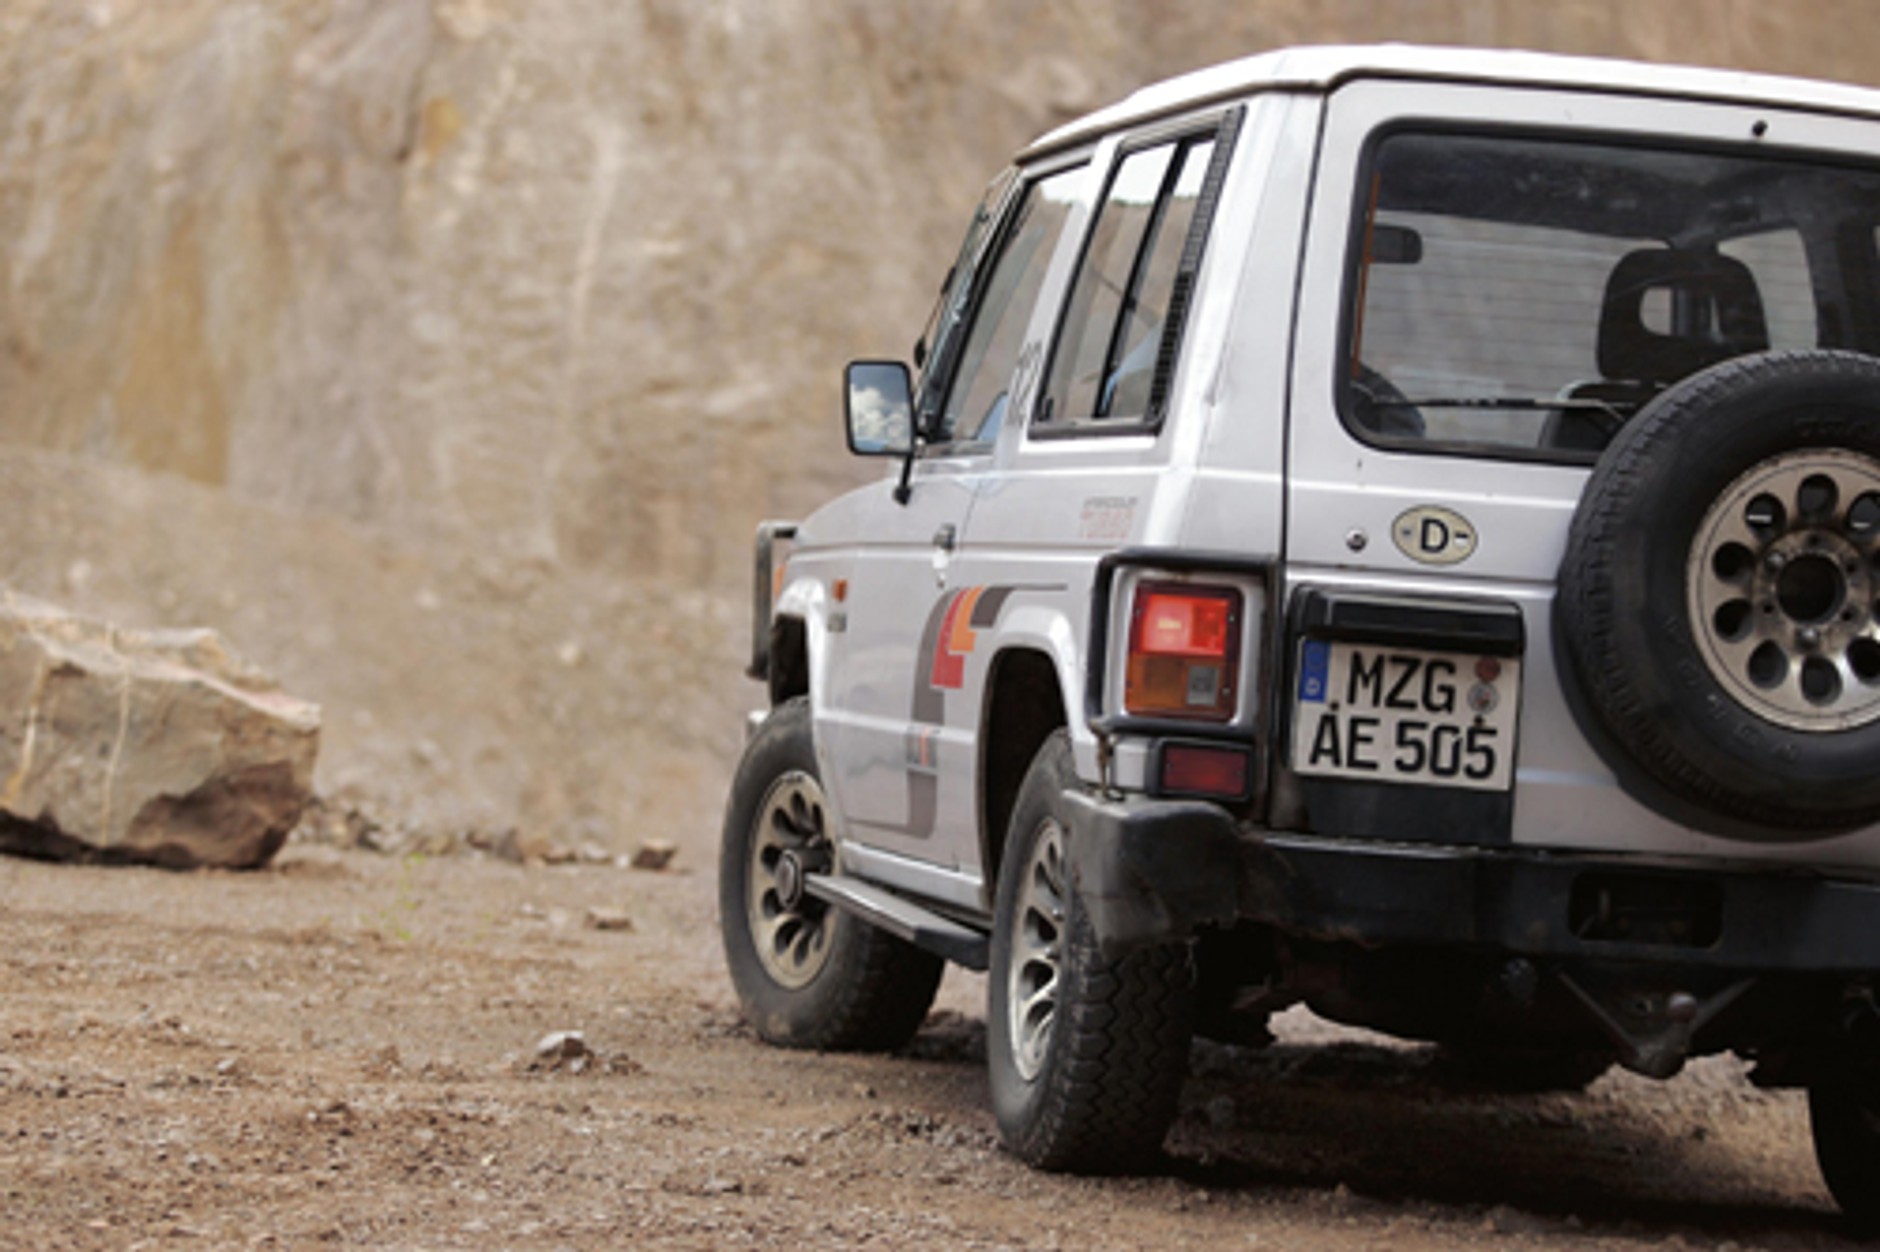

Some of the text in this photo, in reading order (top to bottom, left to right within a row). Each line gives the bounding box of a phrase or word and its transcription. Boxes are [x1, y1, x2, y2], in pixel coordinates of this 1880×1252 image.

[1420, 517, 1449, 553] D
[1346, 651, 1457, 714] MZG
[1308, 713, 1498, 780] AE 505
